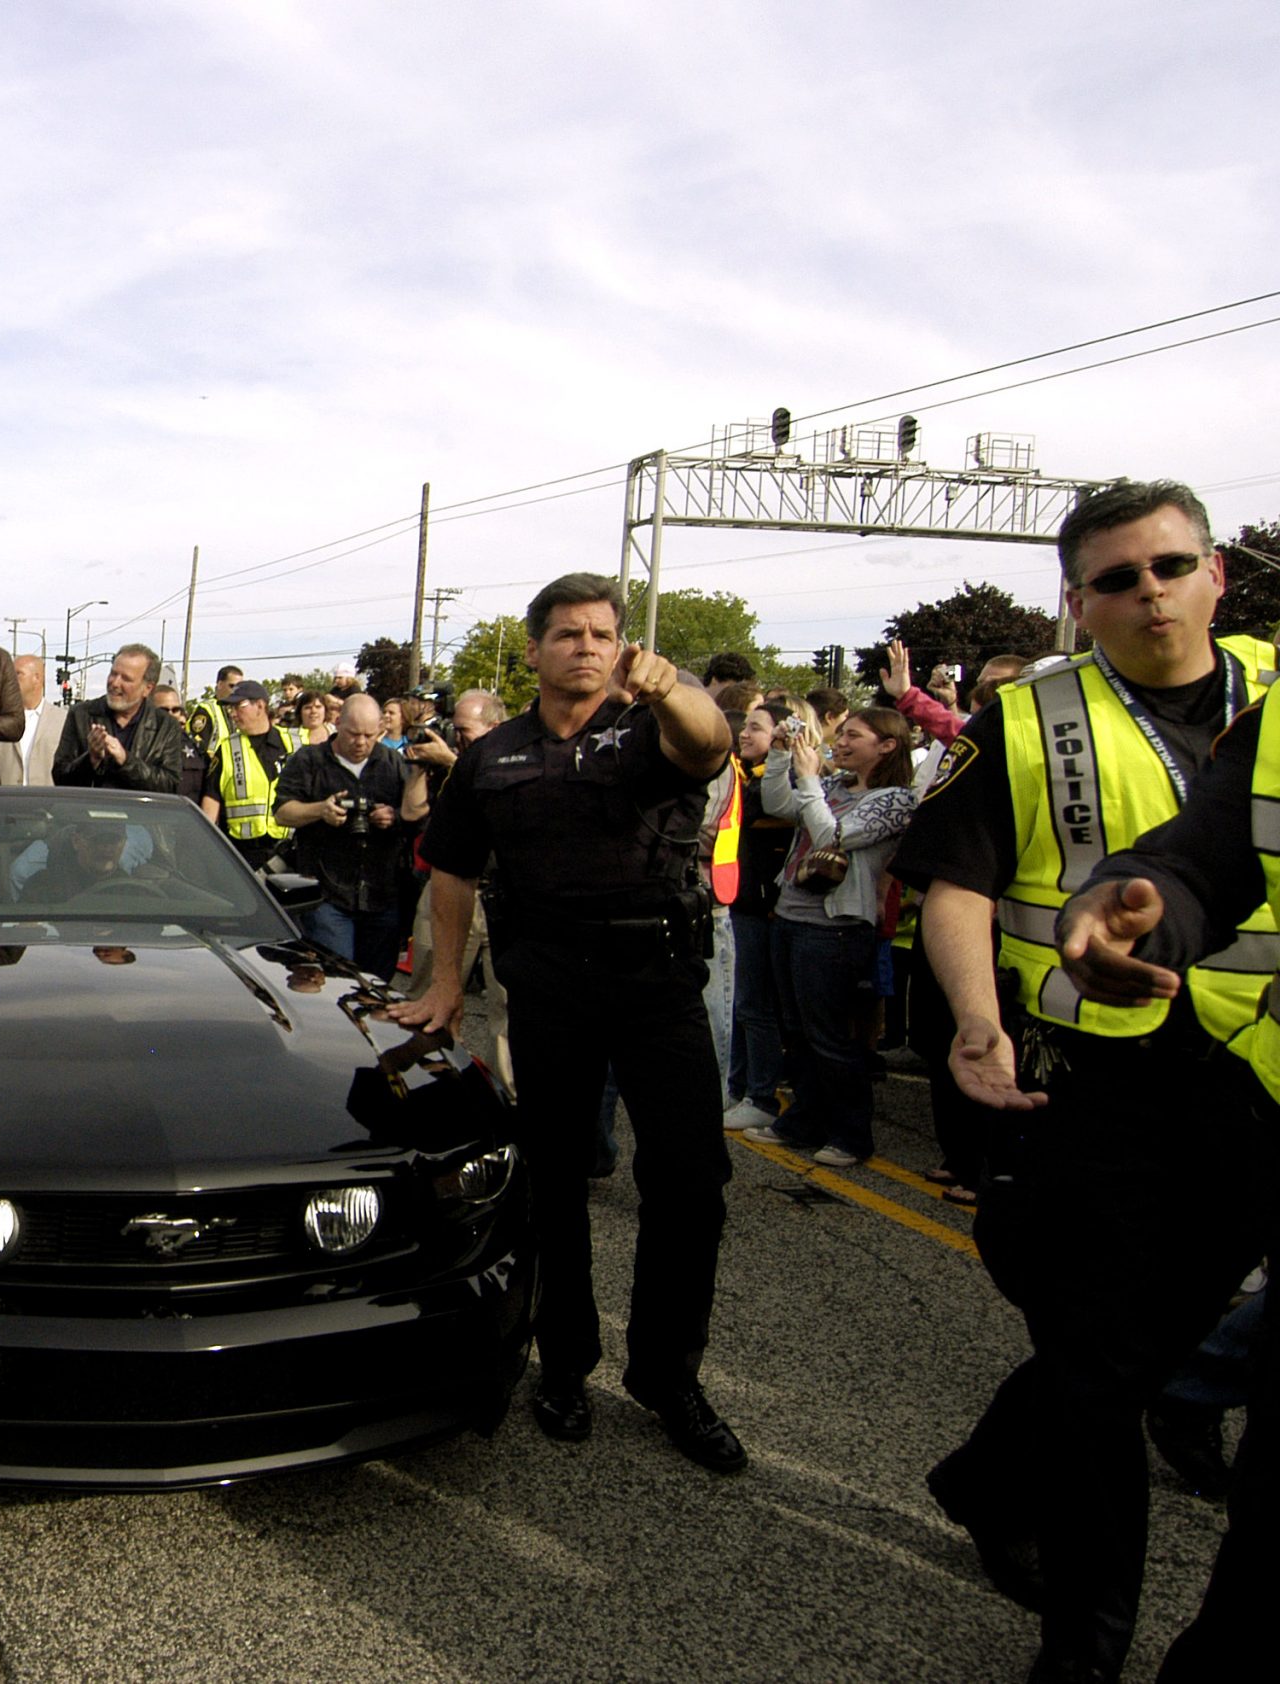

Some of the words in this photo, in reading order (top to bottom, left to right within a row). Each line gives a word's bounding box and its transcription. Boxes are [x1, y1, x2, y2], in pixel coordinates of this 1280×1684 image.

[1107, 677, 1135, 706] MOUNT
[1134, 716, 1157, 737] DEPT
[1151, 736, 1176, 767] POLICE
[233, 751, 244, 786] POLICE
[1053, 721, 1093, 844] POLICE
